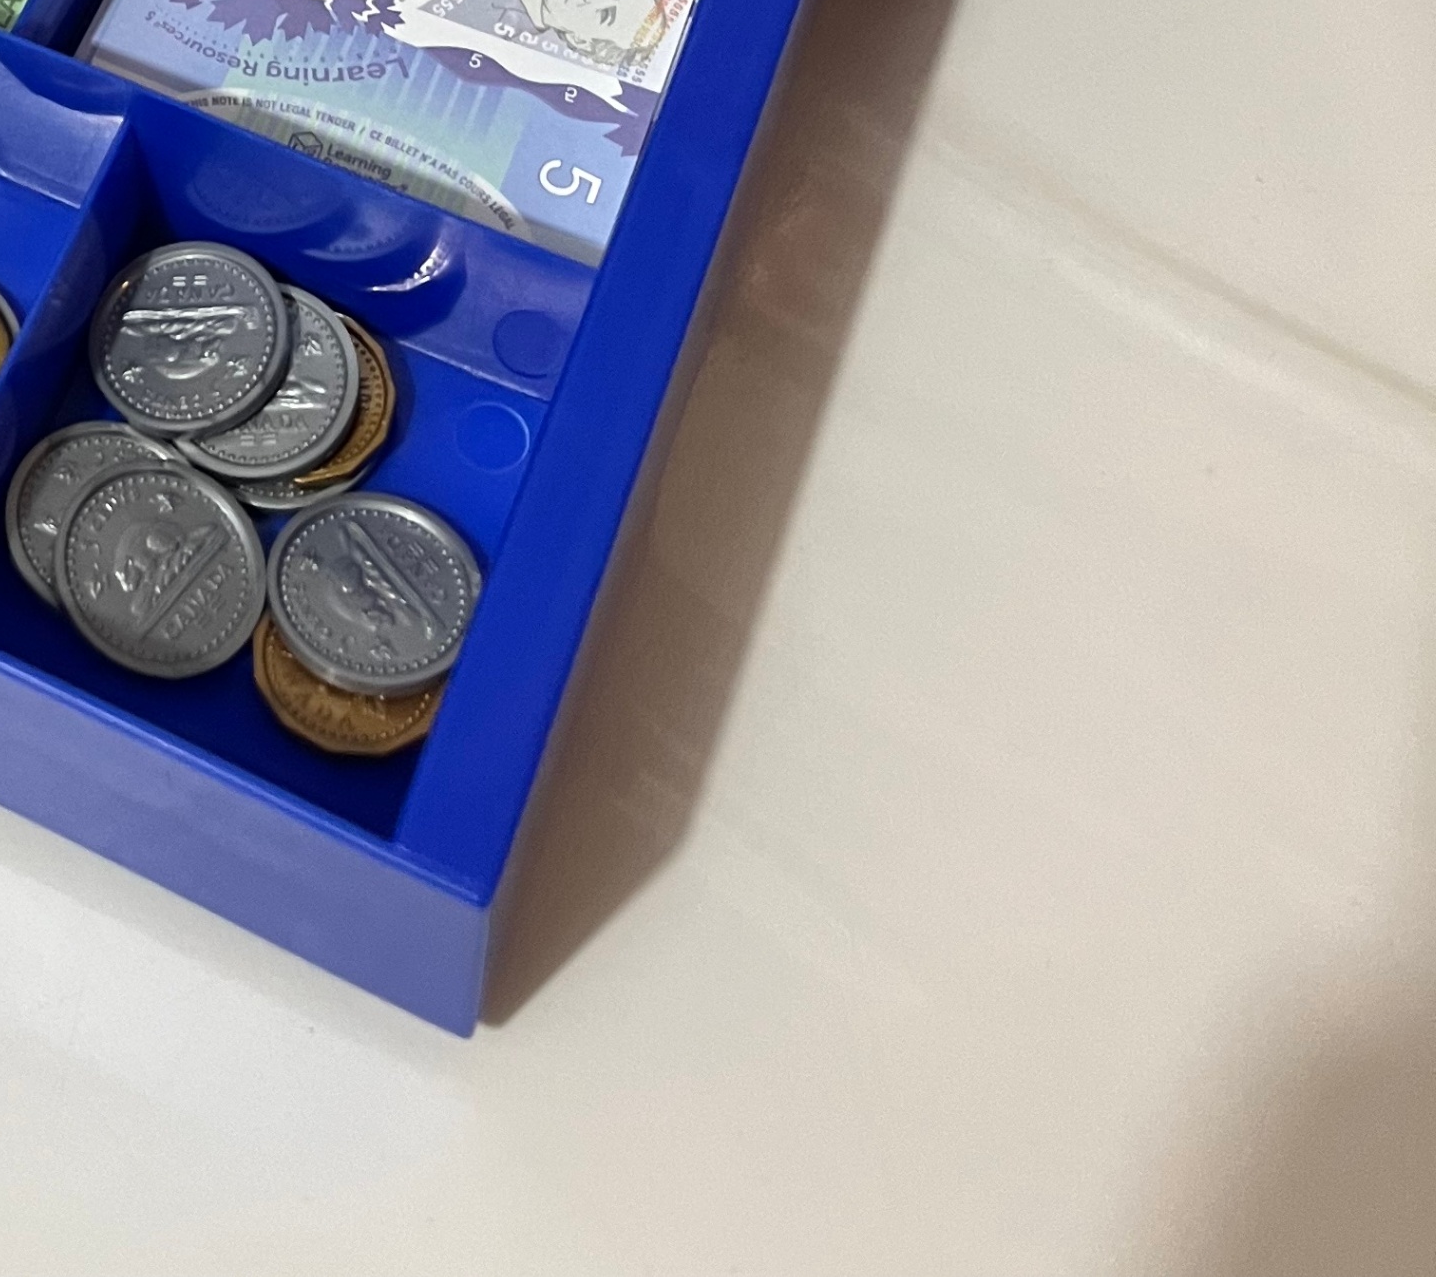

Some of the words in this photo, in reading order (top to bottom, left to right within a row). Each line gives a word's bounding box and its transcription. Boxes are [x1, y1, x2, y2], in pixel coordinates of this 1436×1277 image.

[266, 58, 409, 86] Learning
[469, 53, 482, 68] 5
[212, 97, 239, 107] NOTE
[256, 99, 277, 111] NOT
[280, 102, 312, 119] LEGAL
[315, 107, 356, 131] TENDER
[369, 129, 383, 141] CE
[385, 133, 419, 158] BILLET
[439, 162, 459, 180] PAS
[459, 176, 491, 204] COURS
[326, 143, 392, 180] Learning
[539, 159, 603, 205] 5
[245, 413, 310, 434] NADA
